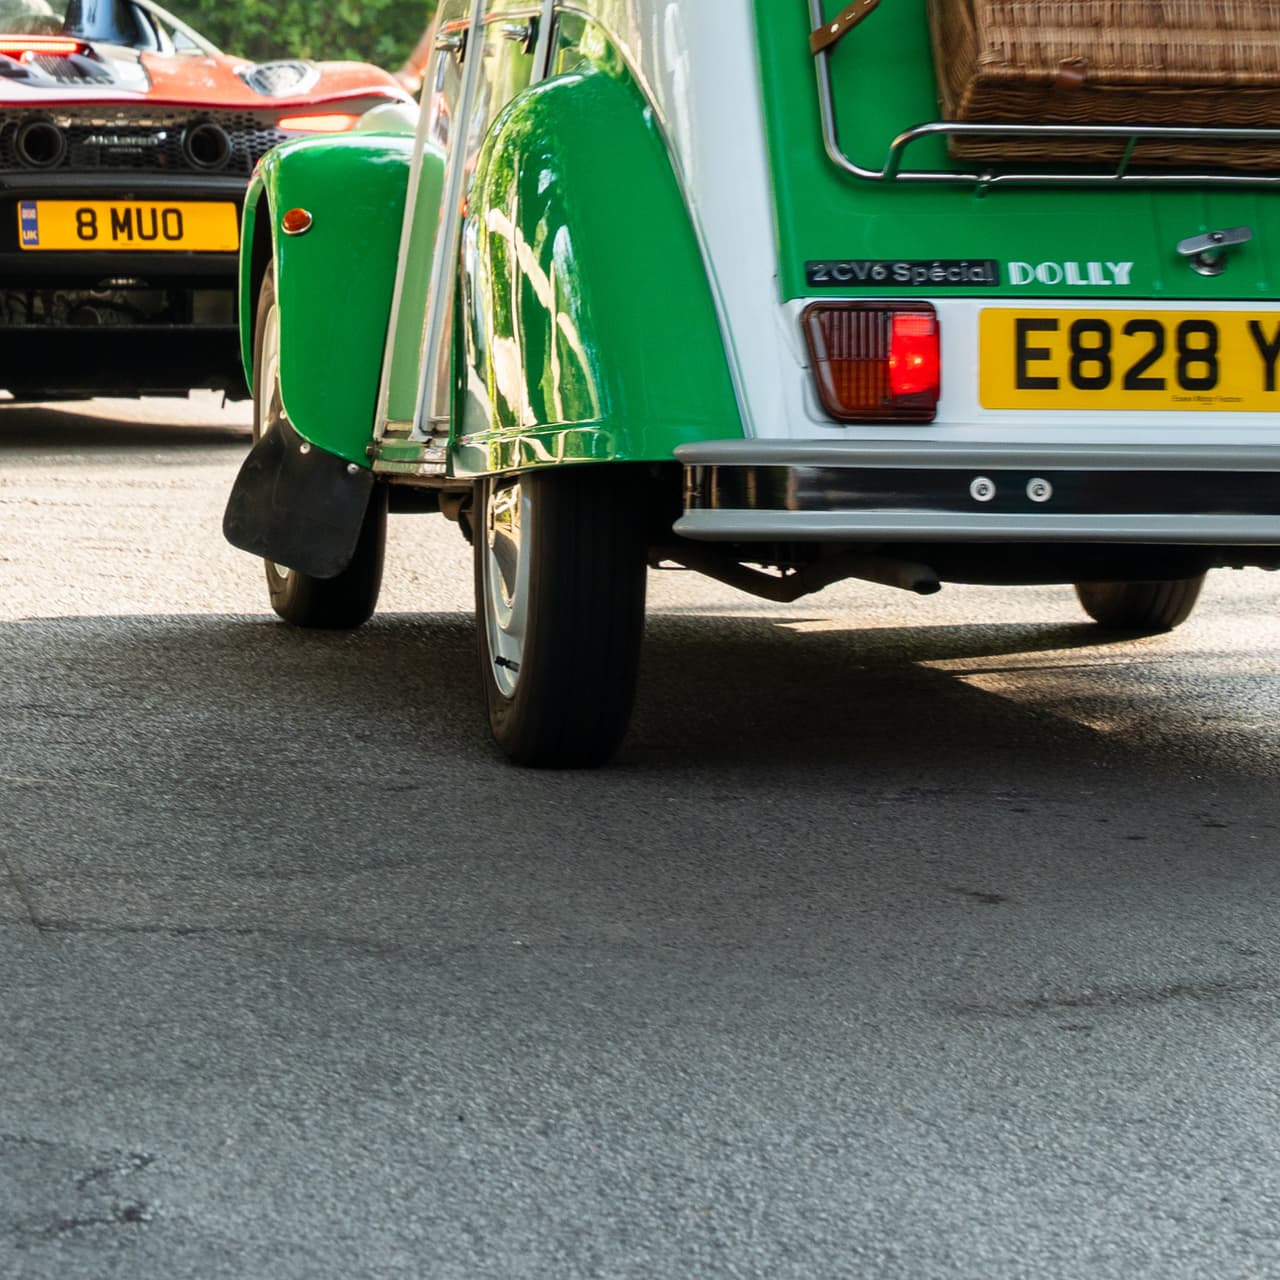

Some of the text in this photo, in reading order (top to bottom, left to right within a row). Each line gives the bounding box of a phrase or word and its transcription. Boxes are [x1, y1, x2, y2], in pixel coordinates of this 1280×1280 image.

[22, 229, 38, 242] UK
[75, 207, 184, 242] 8 MUO
[811, 261, 995, 286] 2CV6 Spécial
[1007, 261, 1134, 286] DOLLY
[1013, 317, 1220, 392] E828
